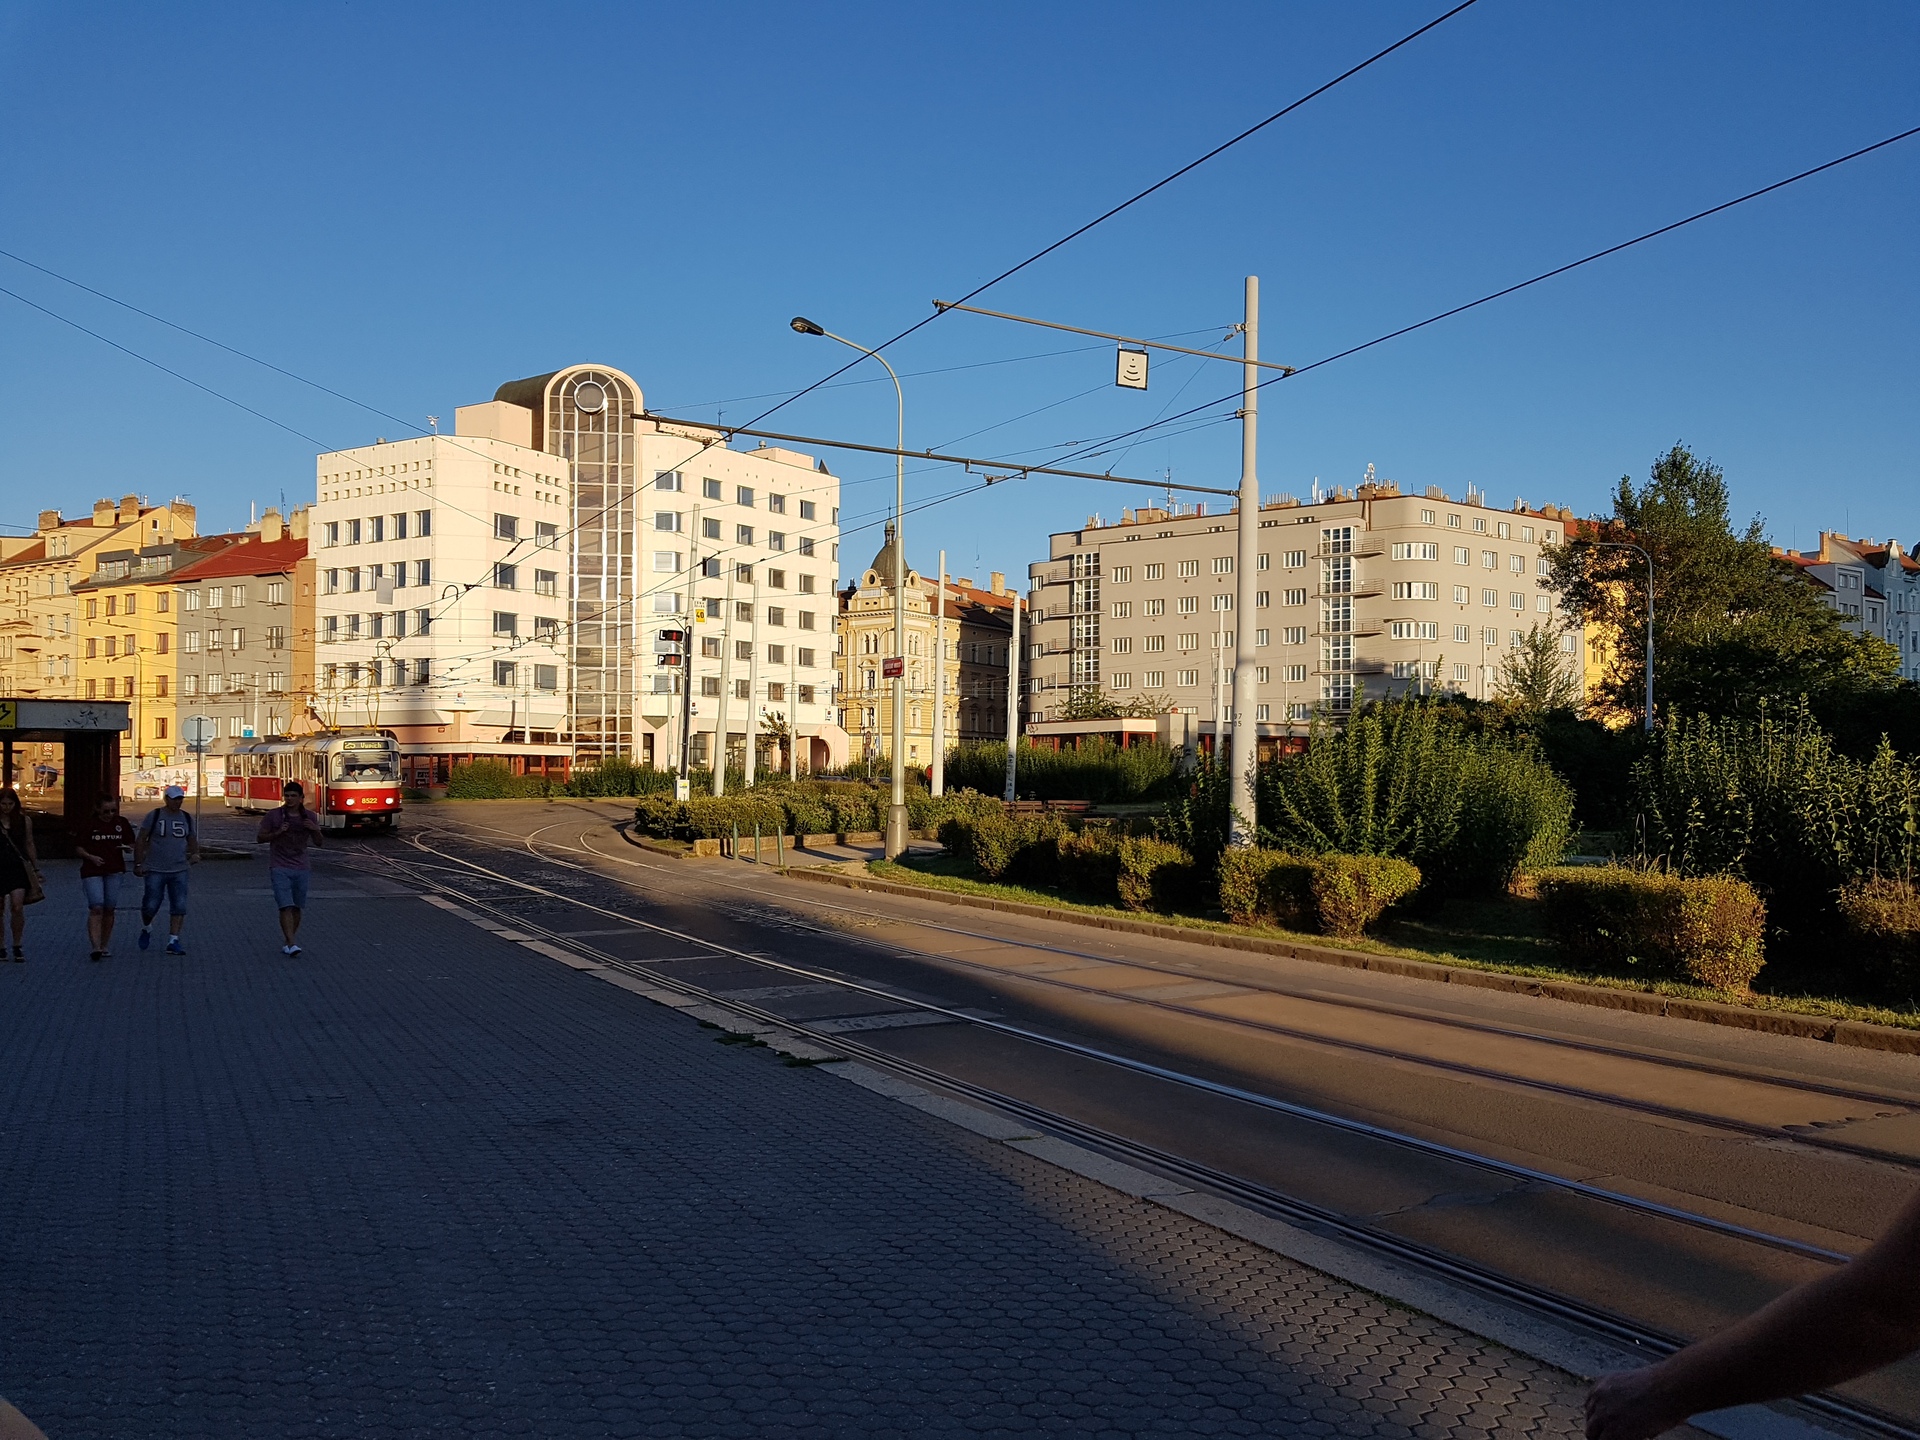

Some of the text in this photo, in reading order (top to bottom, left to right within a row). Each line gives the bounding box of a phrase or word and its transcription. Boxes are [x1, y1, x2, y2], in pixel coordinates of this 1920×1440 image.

[660, 630, 666, 639] L
[659, 656, 665, 664] P
[158, 819, 187, 838] 15
